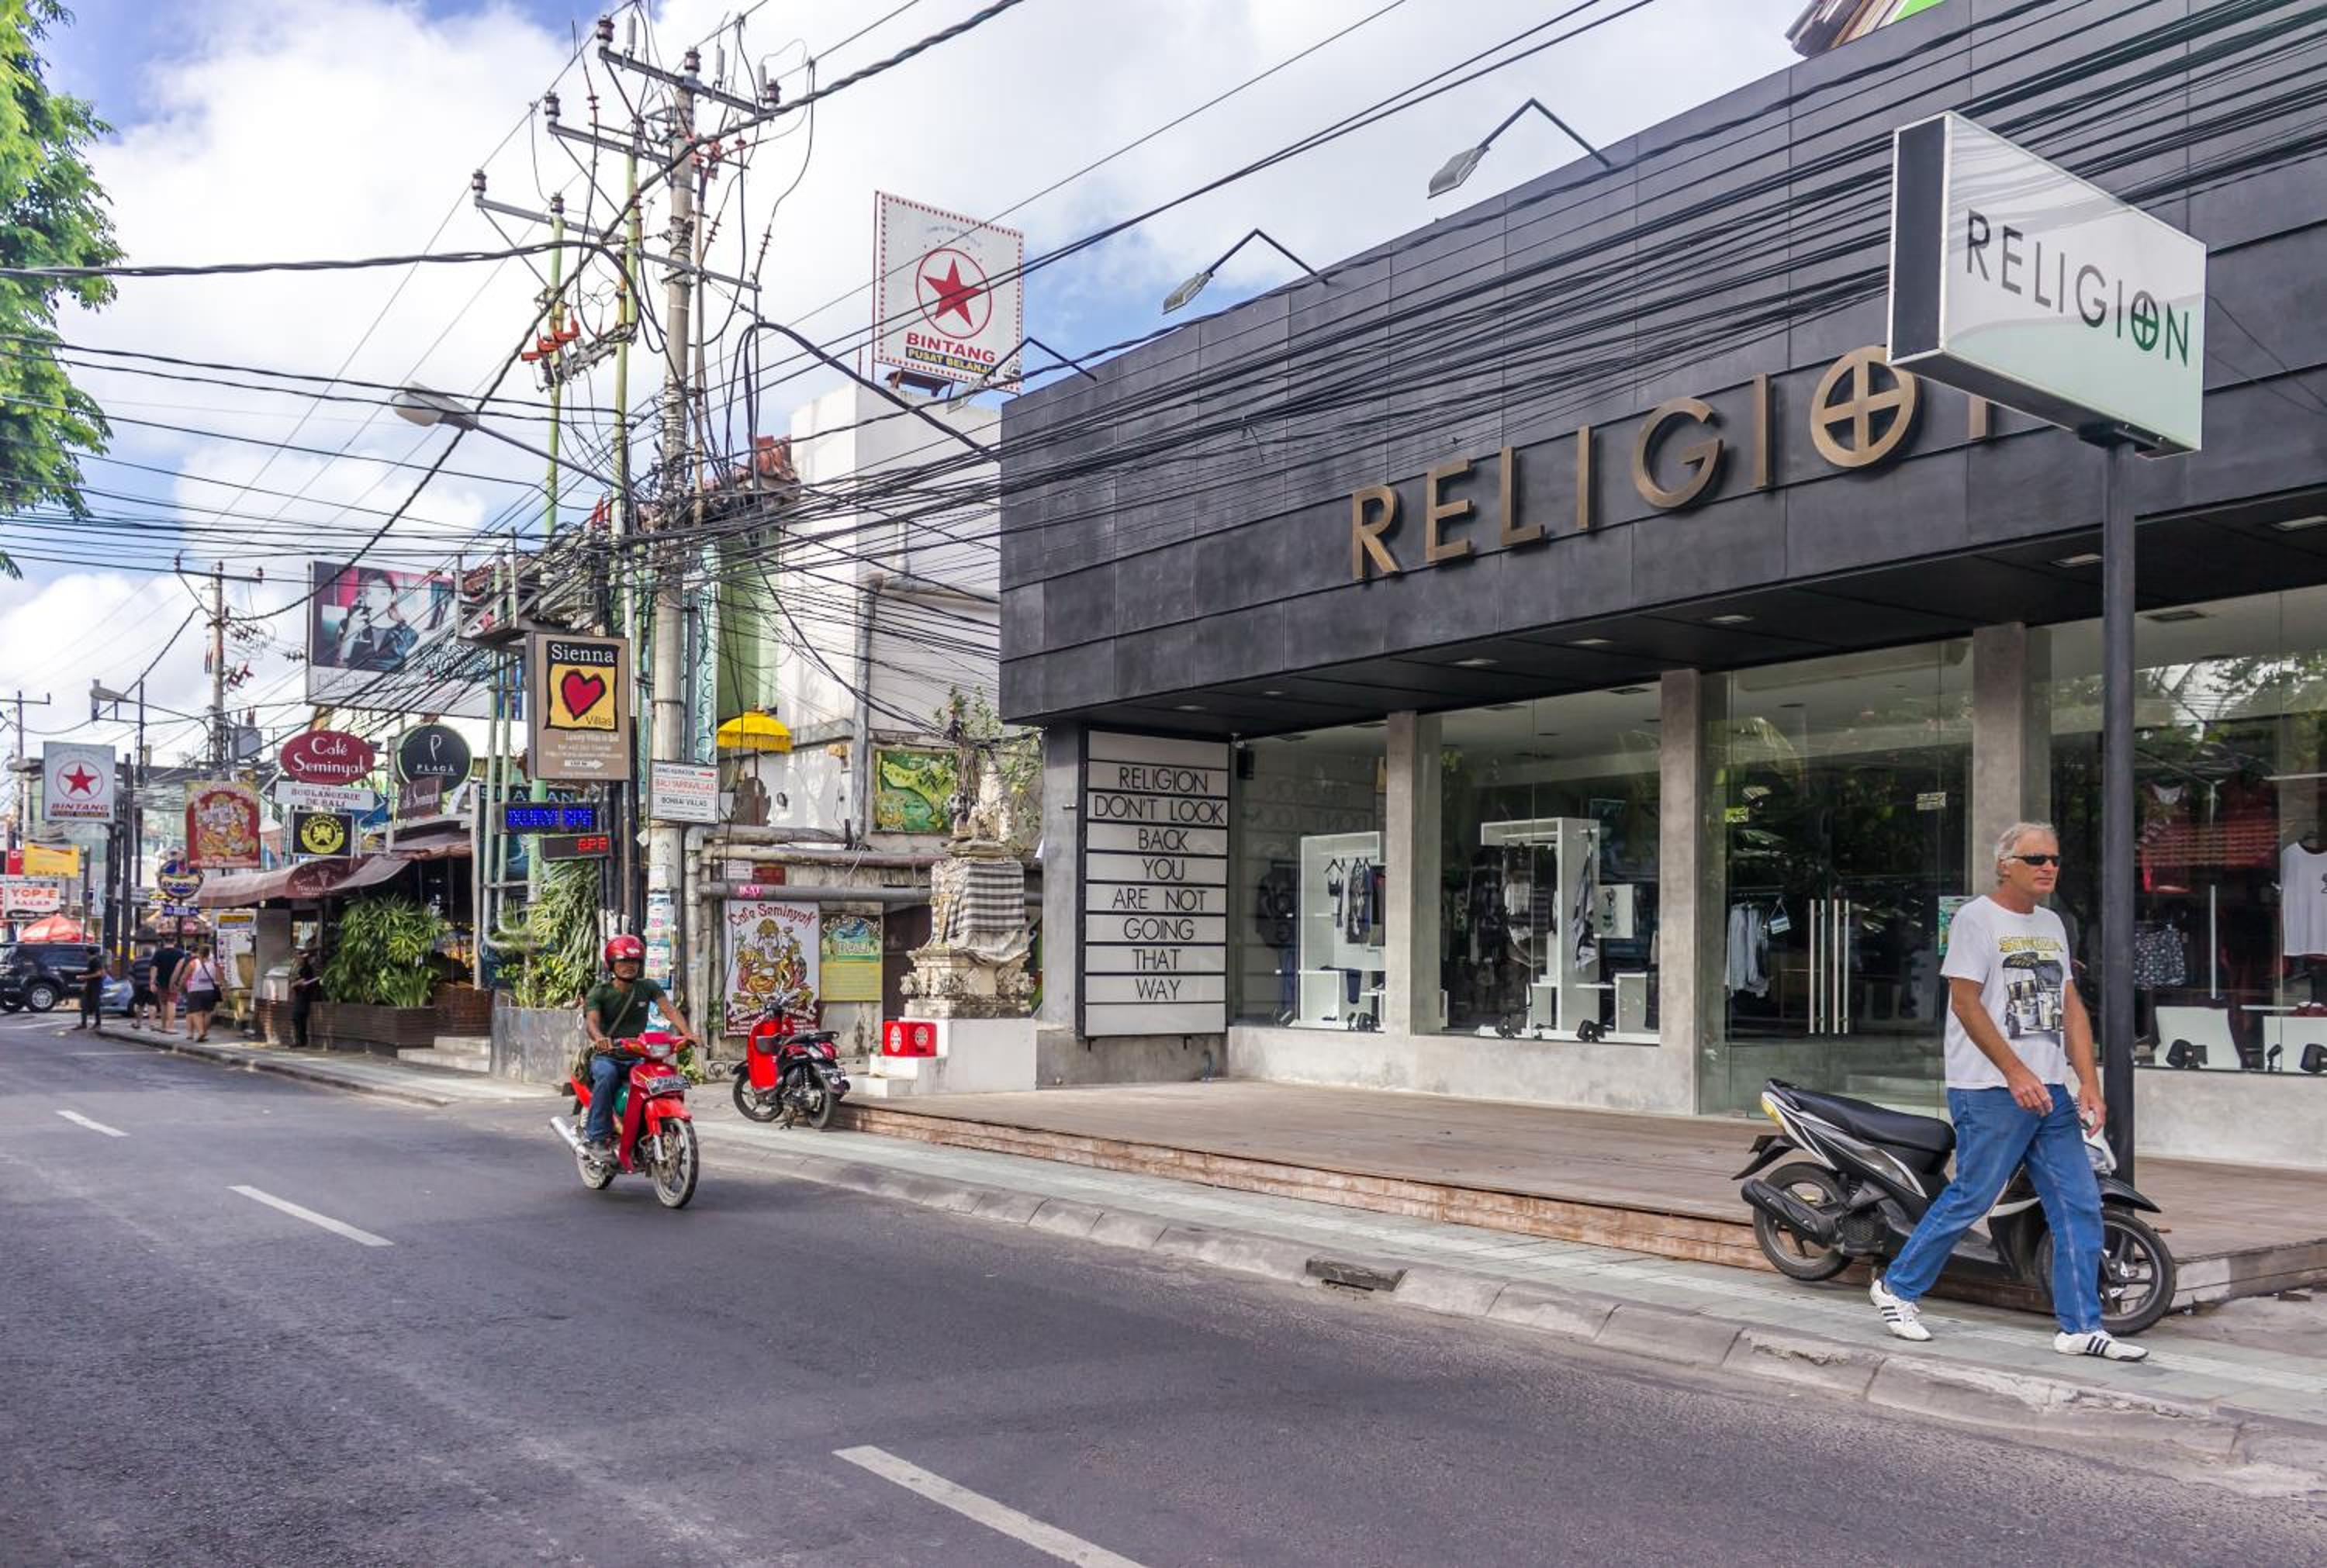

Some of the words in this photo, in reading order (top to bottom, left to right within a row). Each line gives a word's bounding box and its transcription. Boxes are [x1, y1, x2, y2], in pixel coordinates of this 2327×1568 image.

[1966, 209, 2189, 368] RELIGION
[906, 332, 996, 363] BINTANG
[908, 348, 944, 365] PUSAT
[1352, 345, 1990, 582] RELIGIO
[551, 644, 615, 663] Sienna
[586, 716, 613, 727] Villas
[312, 737, 348, 756] Café
[292, 752, 367, 778] Seminyak
[1119, 766, 1208, 794] RELIGION
[322, 799, 346, 807] BALI
[1094, 795, 1158, 820] DON'T
[1170, 800, 1225, 824] LOOK
[1138, 828, 1189, 851] BACK
[1142, 858, 1185, 882] YOU
[1112, 888, 1150, 910] ARE
[1165, 889, 1207, 912] NOT
[728, 907, 755, 927] Cafe
[757, 903, 816, 929] Seminyak
[1123, 918, 1195, 941] GOING
[1132, 948, 1181, 971] THAT
[1135, 979, 1181, 1002] WAY
